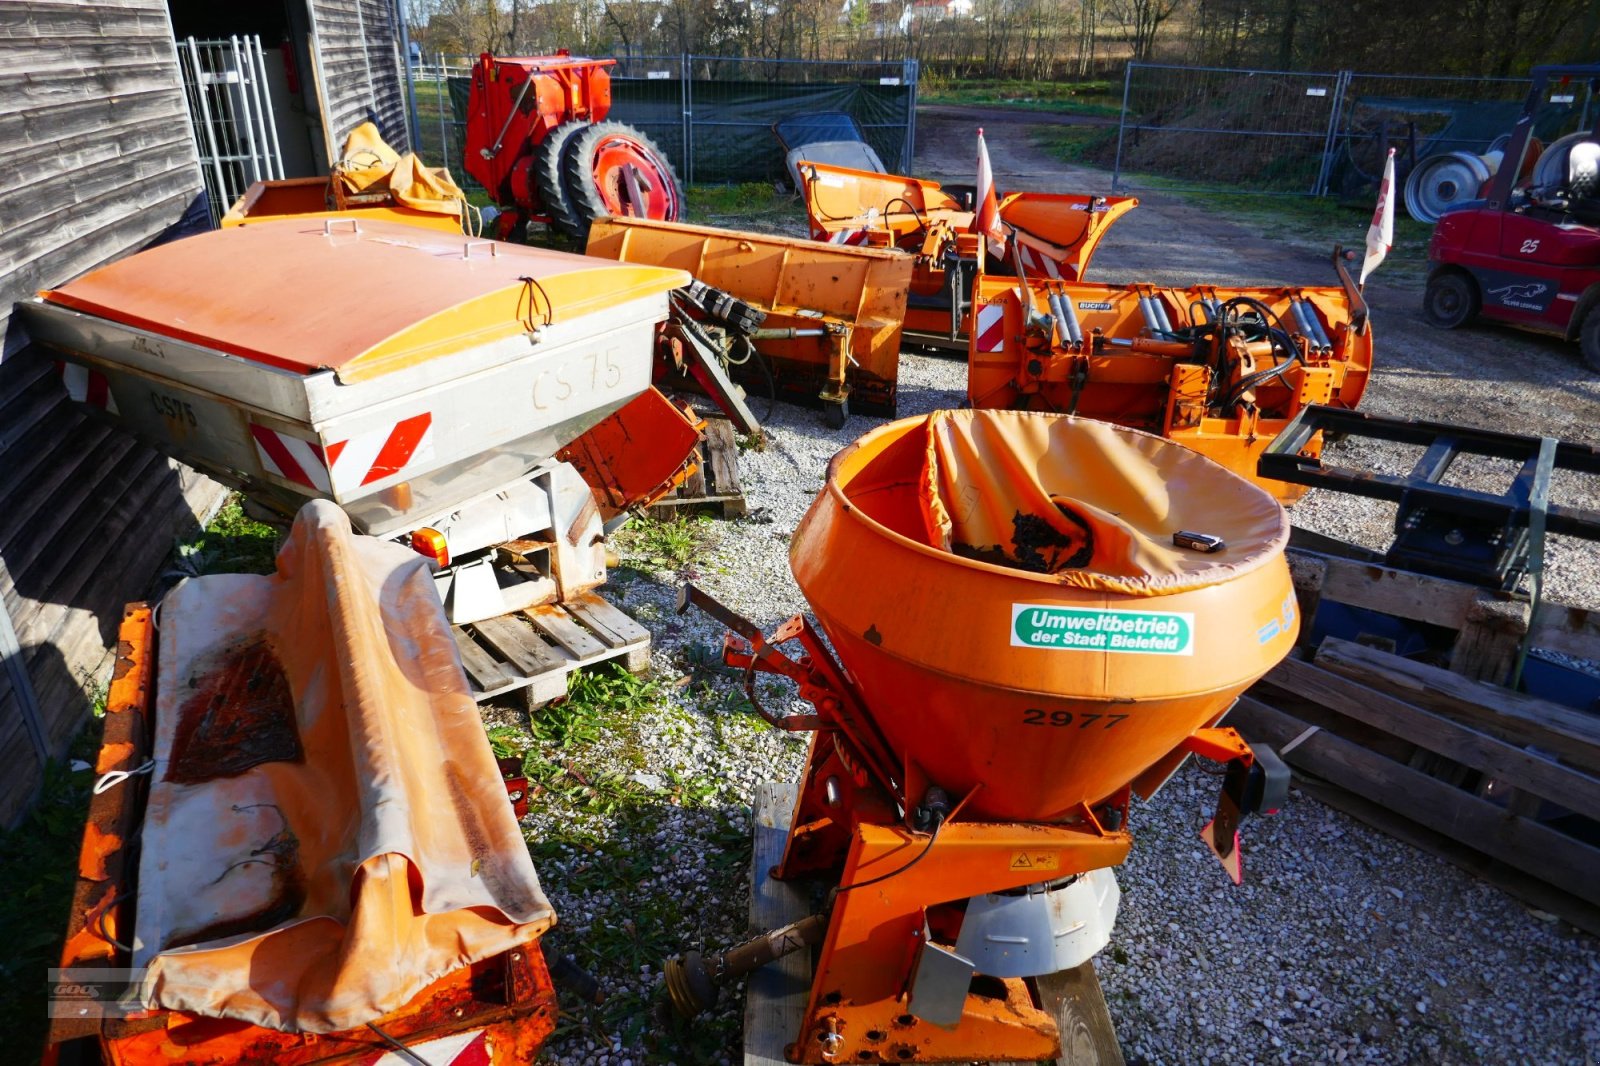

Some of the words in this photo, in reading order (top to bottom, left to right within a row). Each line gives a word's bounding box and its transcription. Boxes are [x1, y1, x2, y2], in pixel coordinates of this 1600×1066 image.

[1520, 239, 1540, 253] 25
[1031, 610, 1180, 635] Umweltbetrieb
[1031, 630, 1060, 644] der
[1063, 631, 1107, 647] Stadt
[1110, 634, 1179, 650] Bielefeld
[1023, 708, 1130, 730] 2977
